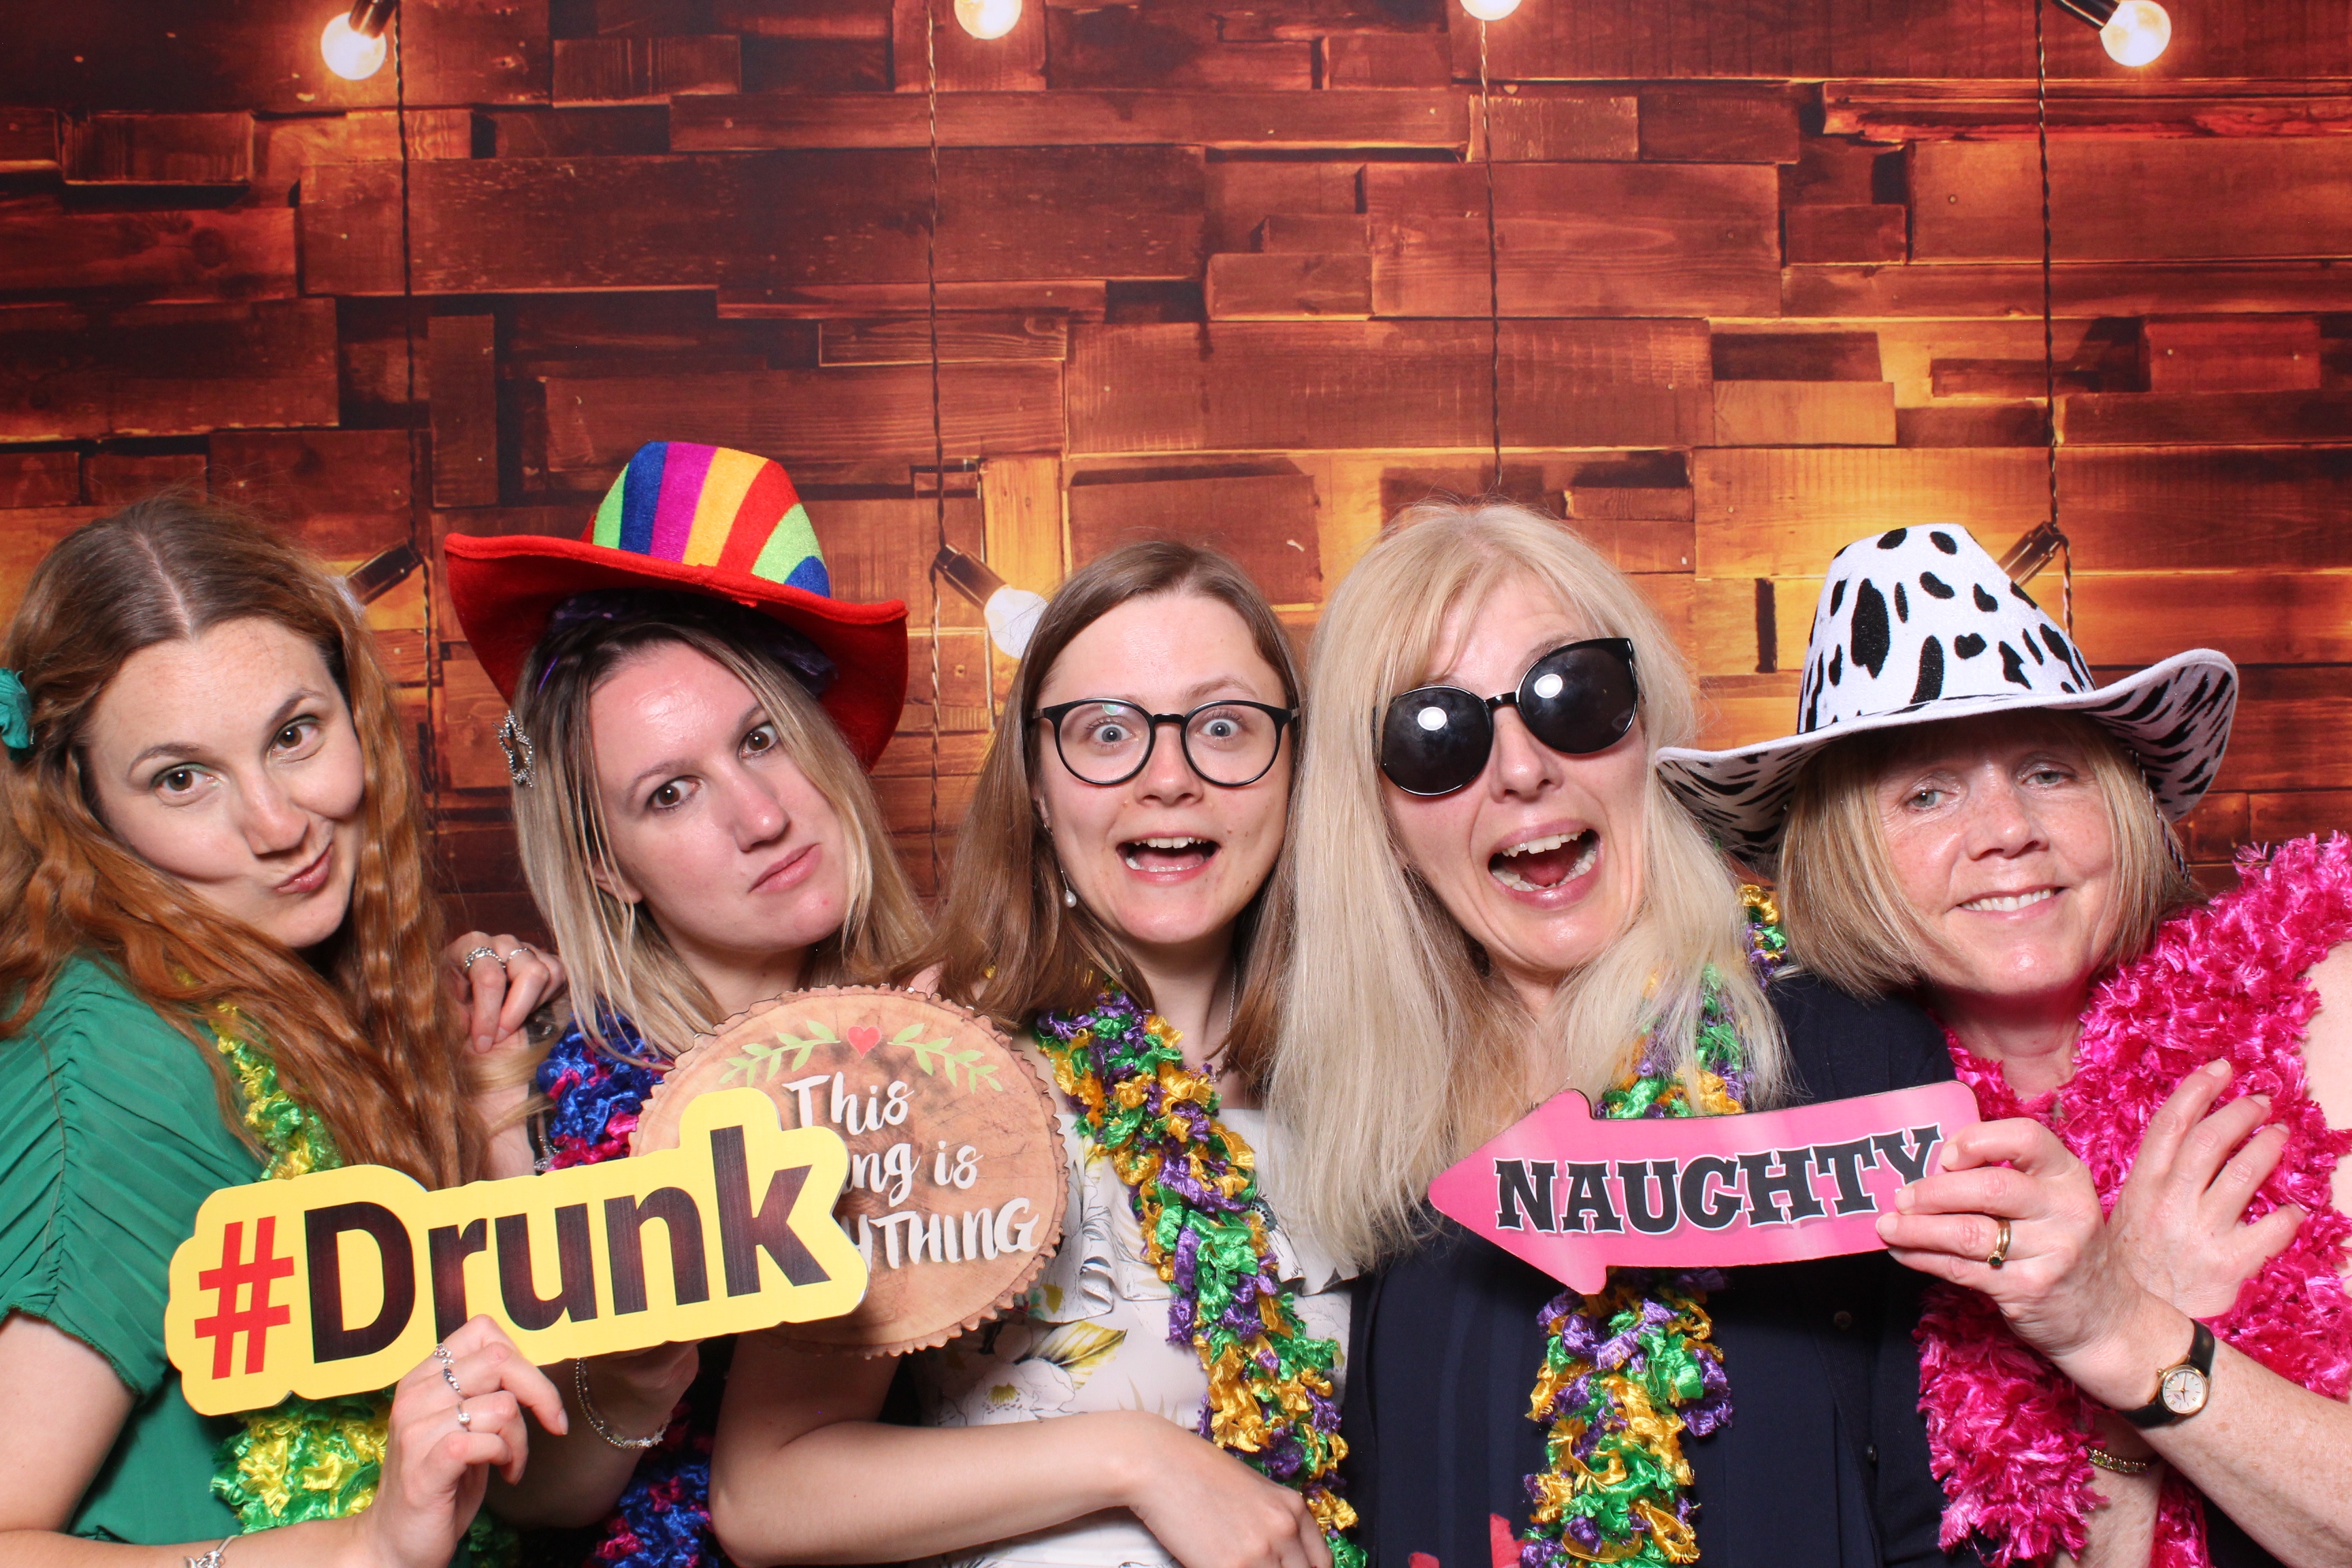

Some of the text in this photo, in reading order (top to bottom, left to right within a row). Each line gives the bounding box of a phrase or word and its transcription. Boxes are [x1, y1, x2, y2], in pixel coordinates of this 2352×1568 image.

[781, 1071, 915, 1136] This
[842, 1140, 984, 1207] ng is
[1494, 1122, 1944, 1235] NAUGHTY
[194, 1126, 832, 1380] #Drunk
[840, 1197, 1040, 1273] YTHING
